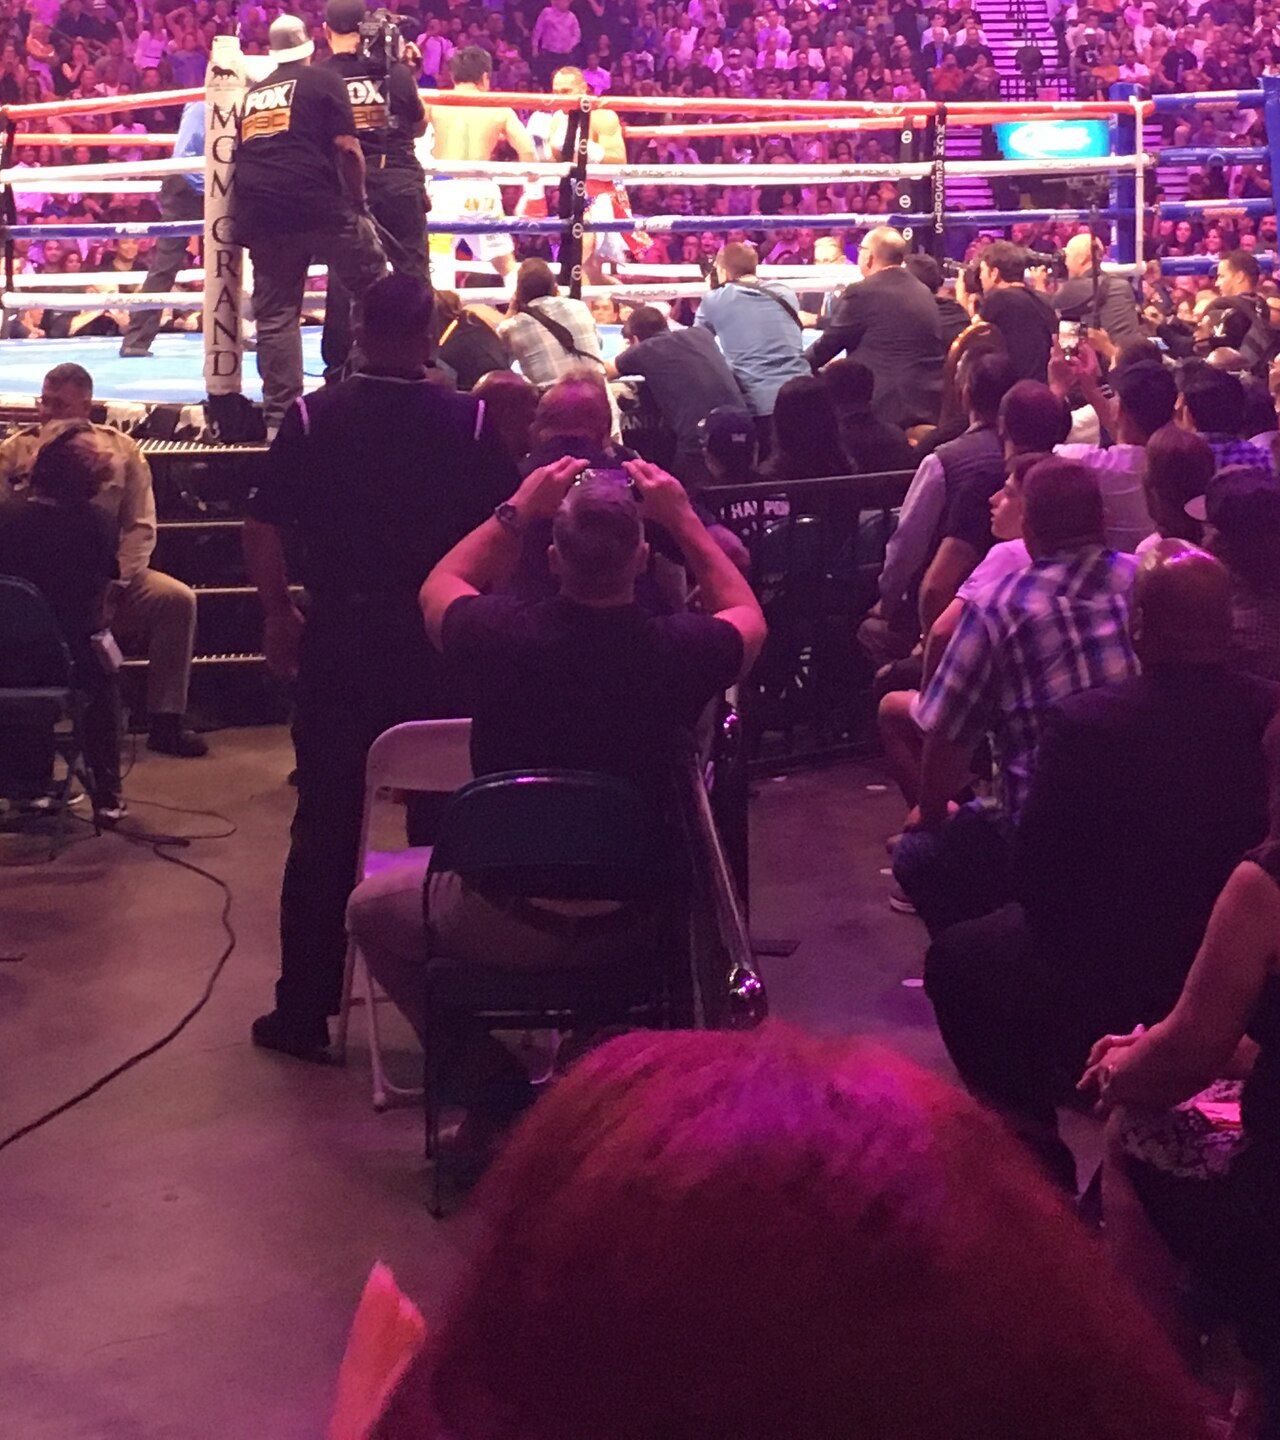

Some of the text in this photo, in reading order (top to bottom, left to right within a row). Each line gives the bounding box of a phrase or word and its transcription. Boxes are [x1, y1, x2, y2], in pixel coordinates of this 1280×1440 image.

[244, 83, 292, 118] FOX
[346, 80, 387, 106] OX
[210, 103, 239, 198] MGM
[935, 160, 945, 234] RESORTS
